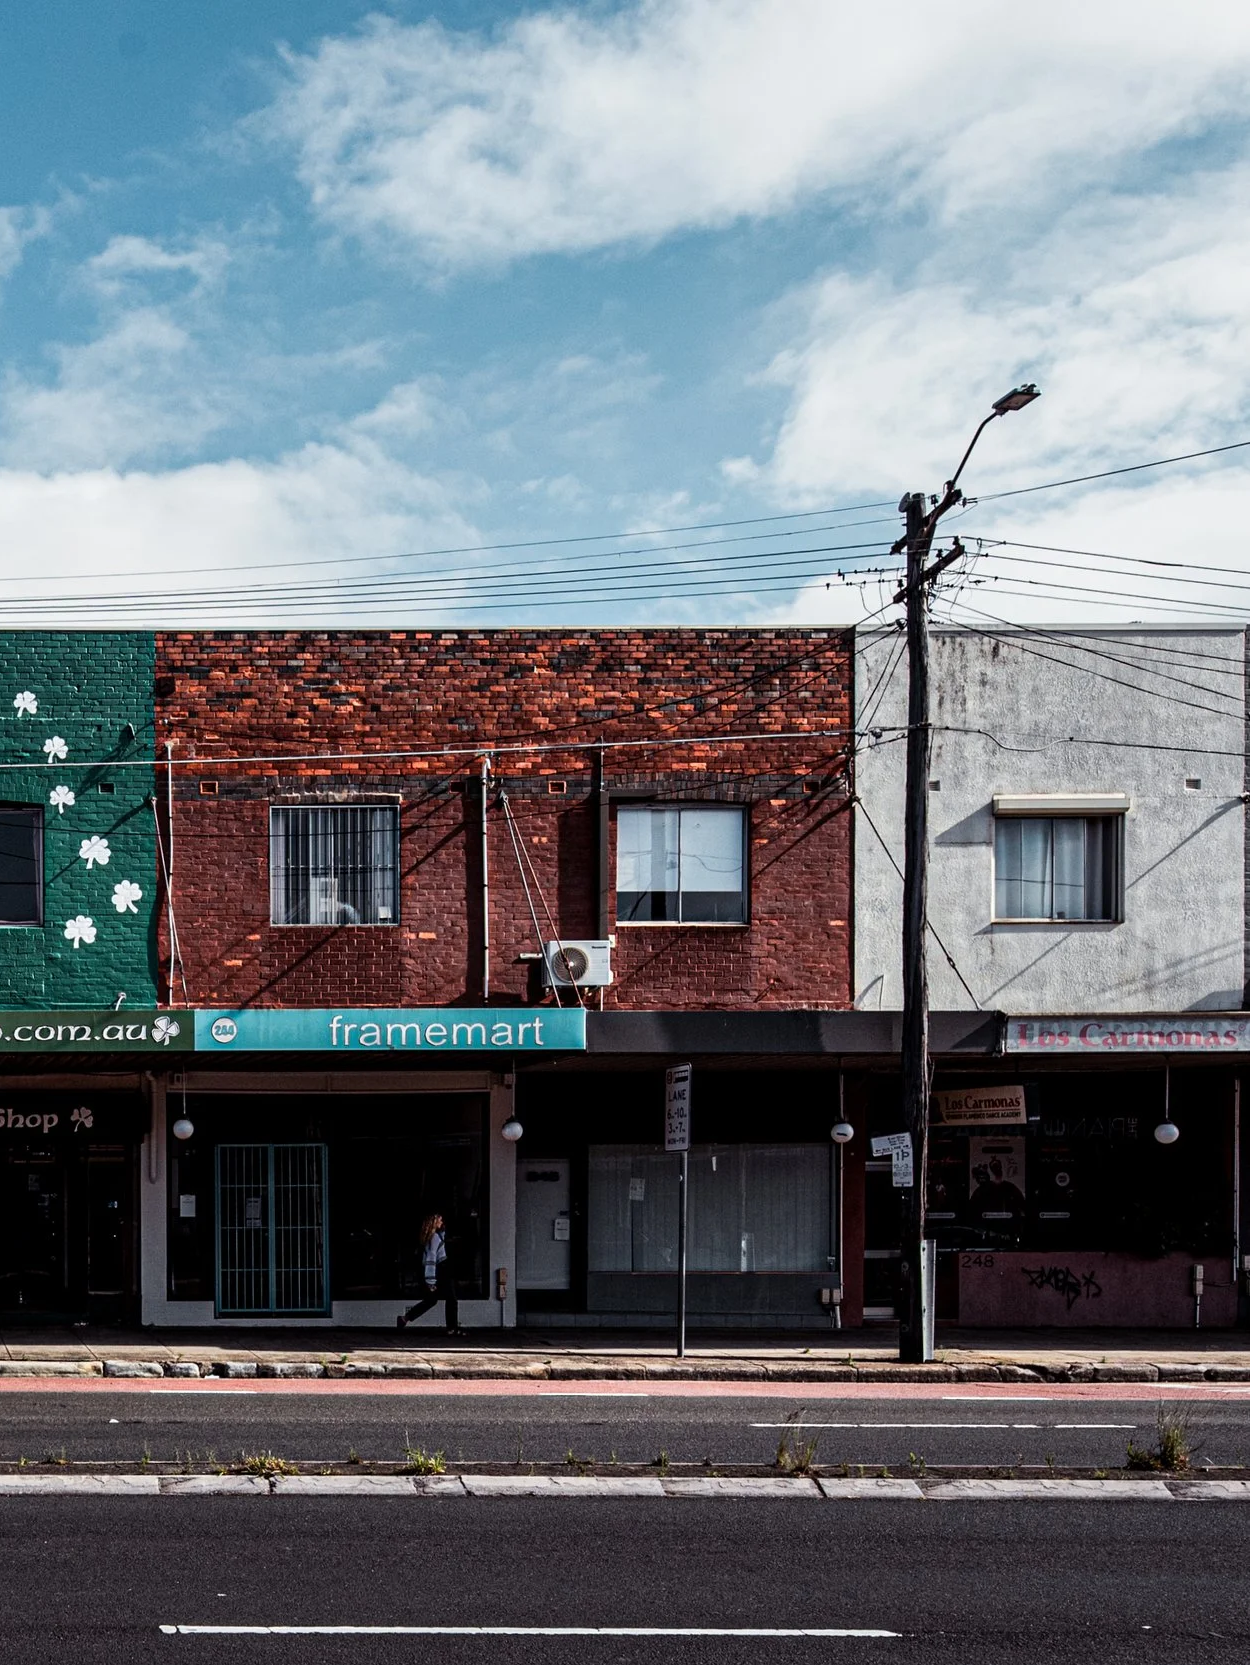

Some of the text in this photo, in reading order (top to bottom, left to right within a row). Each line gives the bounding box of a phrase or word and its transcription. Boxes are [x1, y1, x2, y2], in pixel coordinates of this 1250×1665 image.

[329, 1015, 544, 1046] framemart
[1017, 1023, 1070, 1047] Los
[1079, 1023, 1238, 1047] Carmonas
[668, 1089, 686, 1102] LANE
[945, 1096, 1021, 1110] Los Carmonas
[896, 1151, 909, 1161] 1P
[961, 1255, 994, 1268] 248
